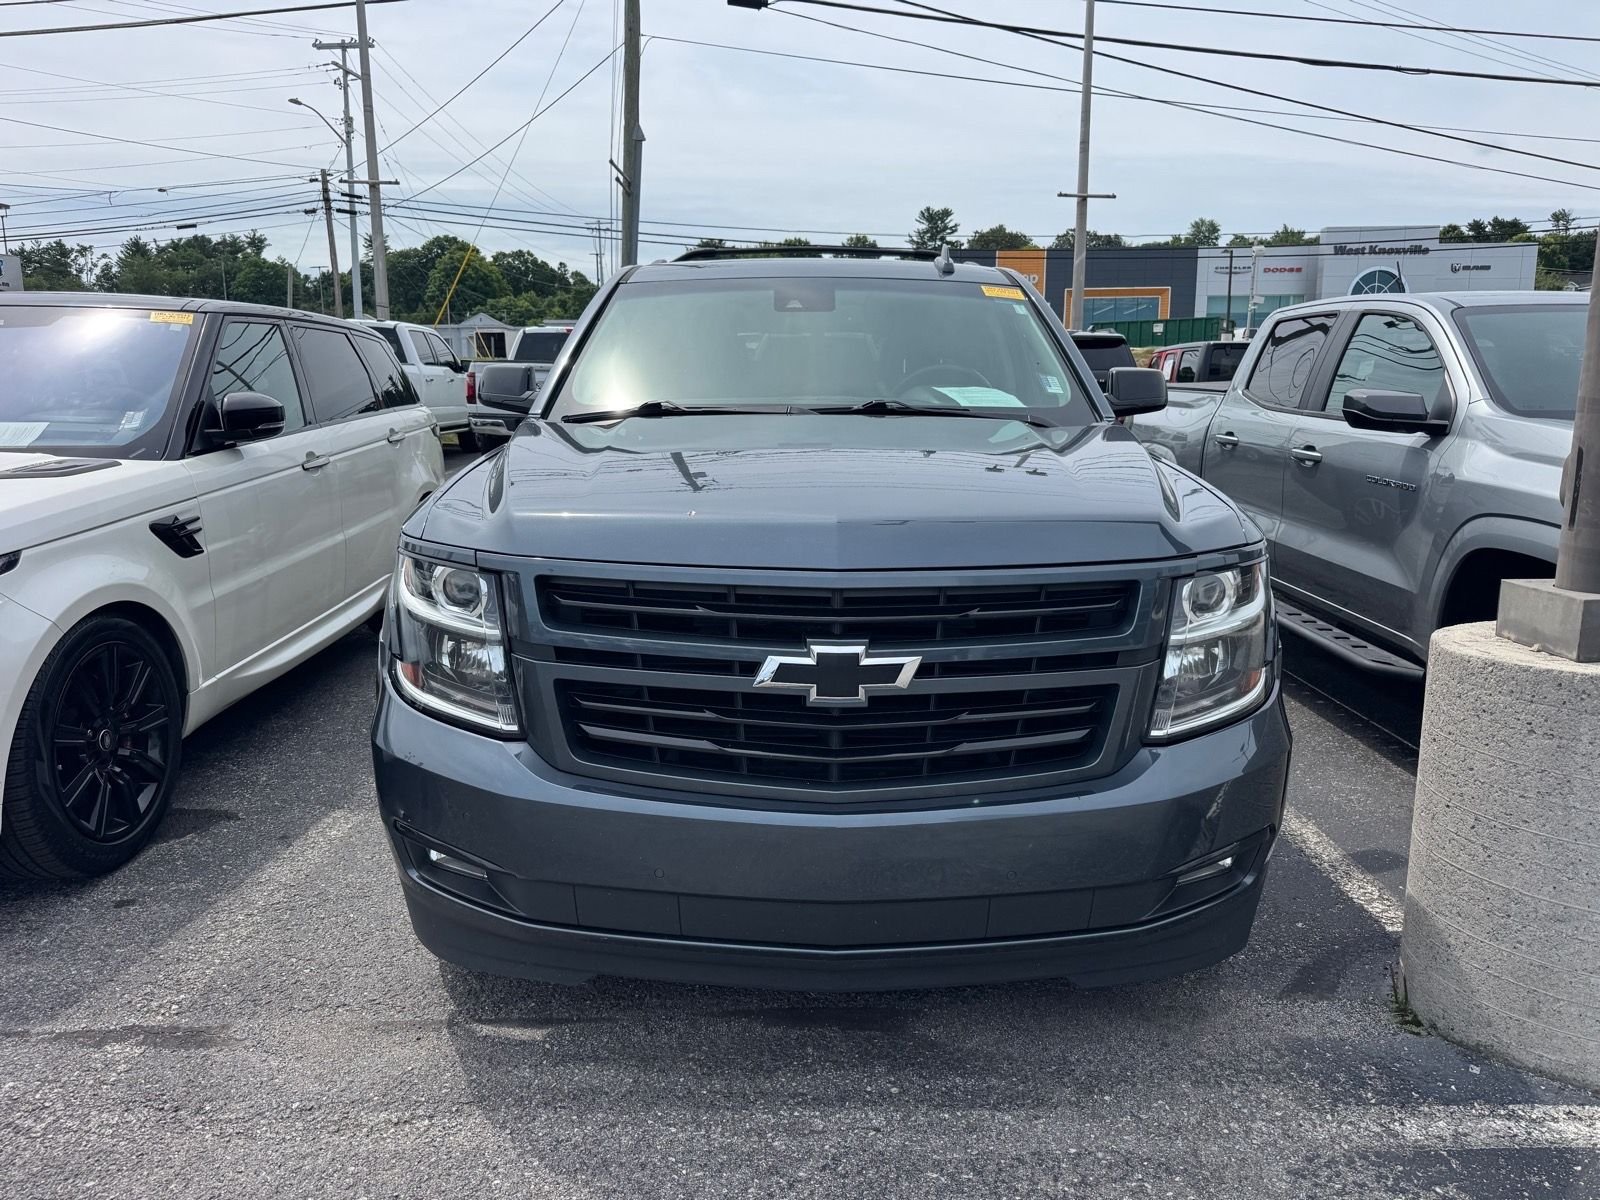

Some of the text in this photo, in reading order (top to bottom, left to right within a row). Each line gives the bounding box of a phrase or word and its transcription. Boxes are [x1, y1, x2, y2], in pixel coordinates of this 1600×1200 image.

[1333, 244, 1430, 255] West Knoxville
[1366, 474, 1416, 491] COLORADO
